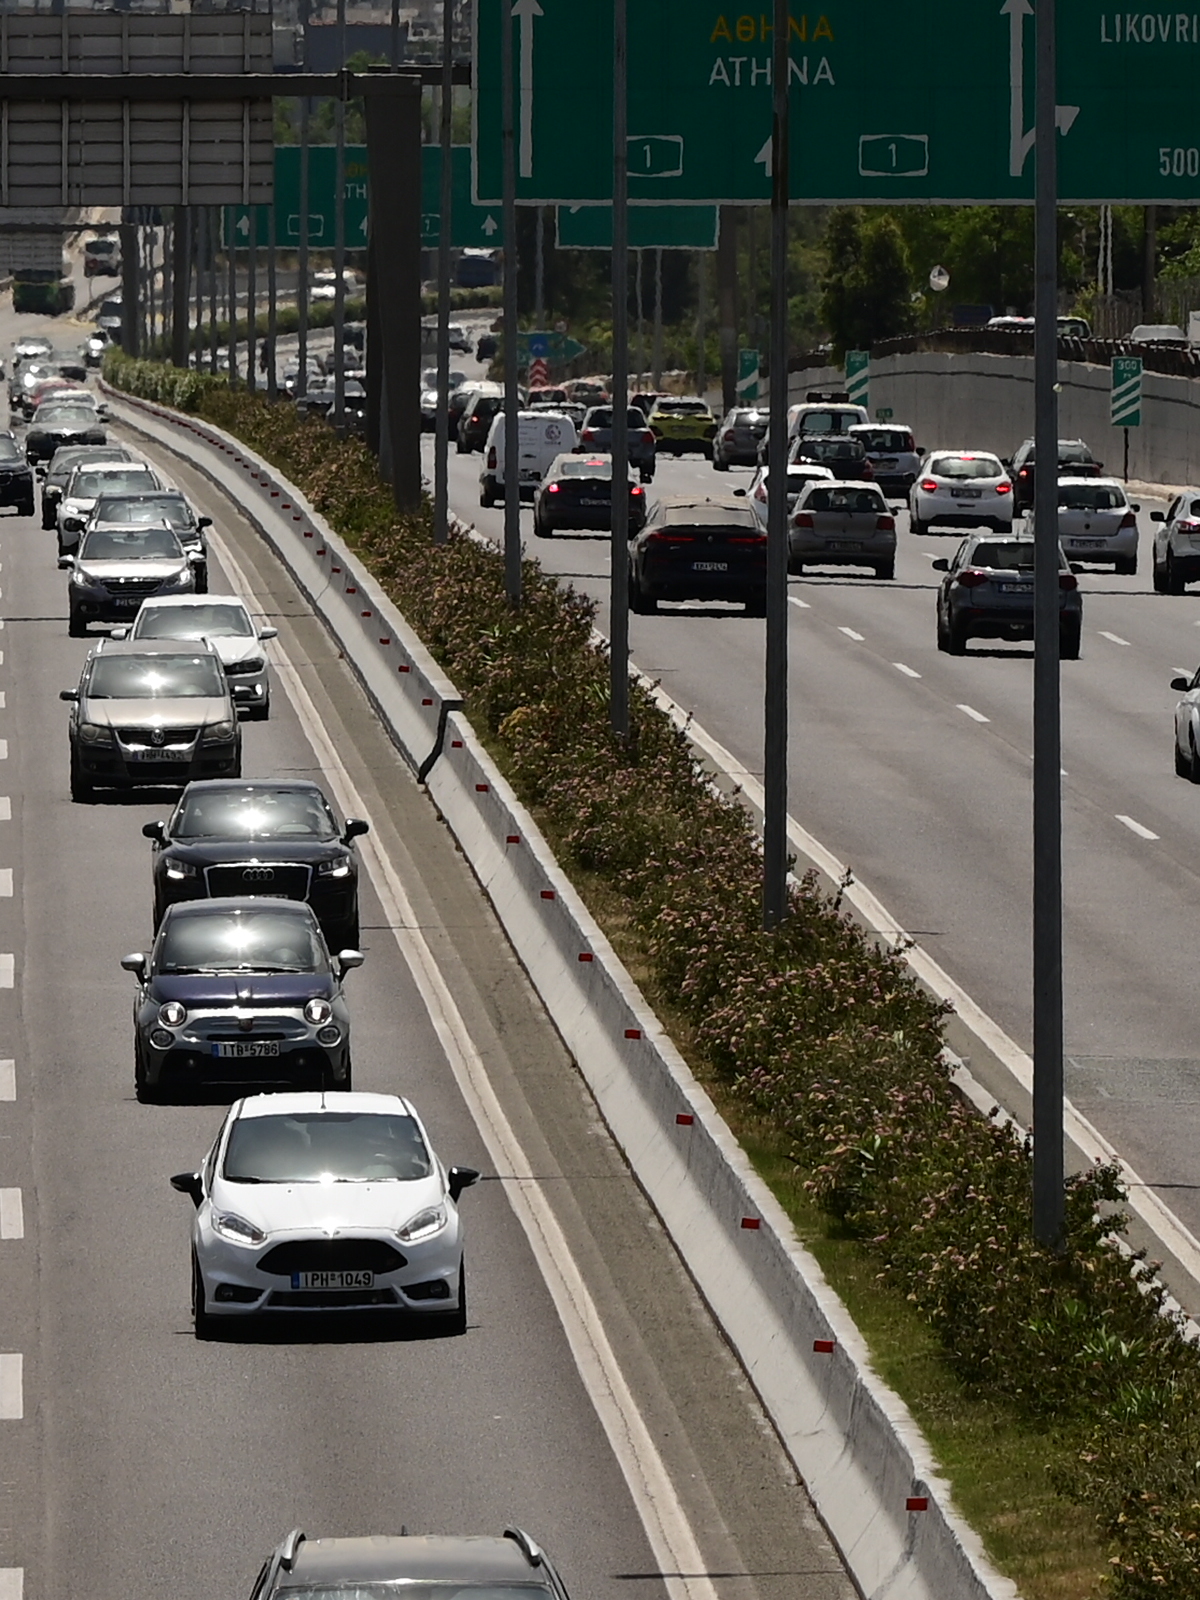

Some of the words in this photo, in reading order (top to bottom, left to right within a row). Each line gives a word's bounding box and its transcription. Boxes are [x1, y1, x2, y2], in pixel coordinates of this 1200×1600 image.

[708, 56, 836, 87] ATHNA
[642, 144, 651, 168] 1
[888, 143, 897, 167] 1
[1158, 147, 1200, 177] 500
